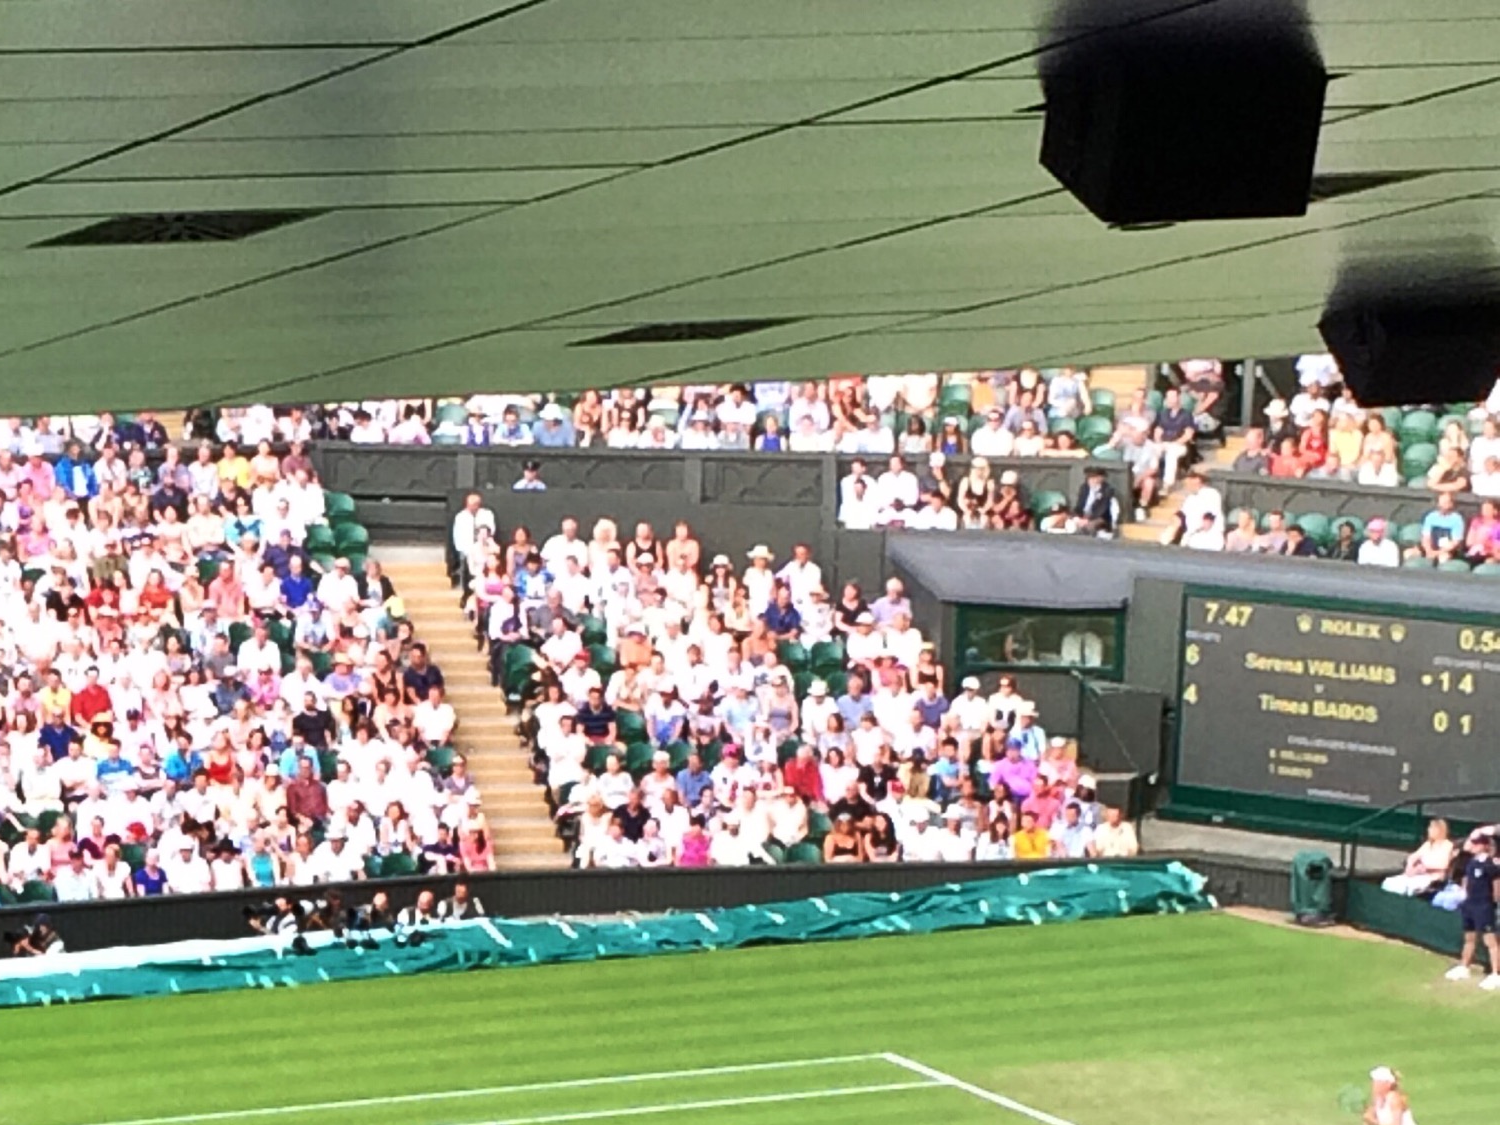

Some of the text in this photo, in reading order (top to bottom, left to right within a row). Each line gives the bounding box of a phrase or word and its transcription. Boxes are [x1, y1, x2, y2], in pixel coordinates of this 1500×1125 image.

[1205, 602, 1253, 626] 7.47
[1320, 619, 1381, 639] ROLEX
[1185, 643, 1200, 665] 6
[1307, 660, 1397, 685] WILLIAMS
[1183, 683, 1198, 704] 4
